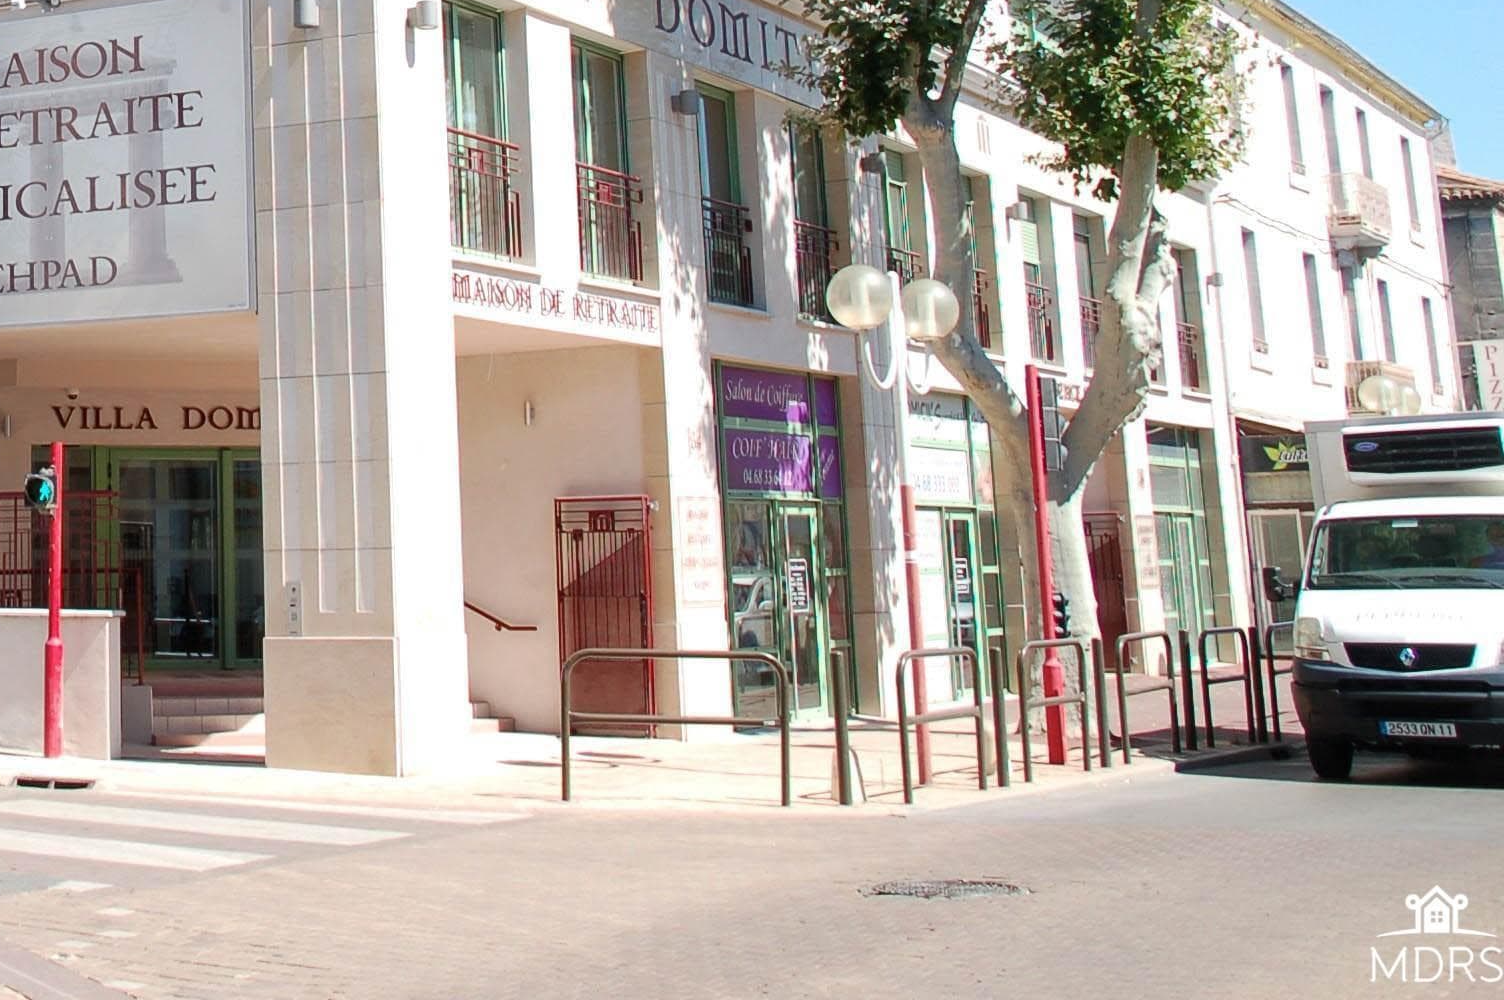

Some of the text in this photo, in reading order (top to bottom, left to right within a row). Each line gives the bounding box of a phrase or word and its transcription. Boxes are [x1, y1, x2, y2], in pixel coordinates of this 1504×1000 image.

[452, 272, 658, 333] MAISON DE RETRAITE
[725, 379, 752, 401] Salon
[754, 381, 765, 403] de
[51, 405, 158, 430] VILLA
[1439, 724, 1452, 736] 11
